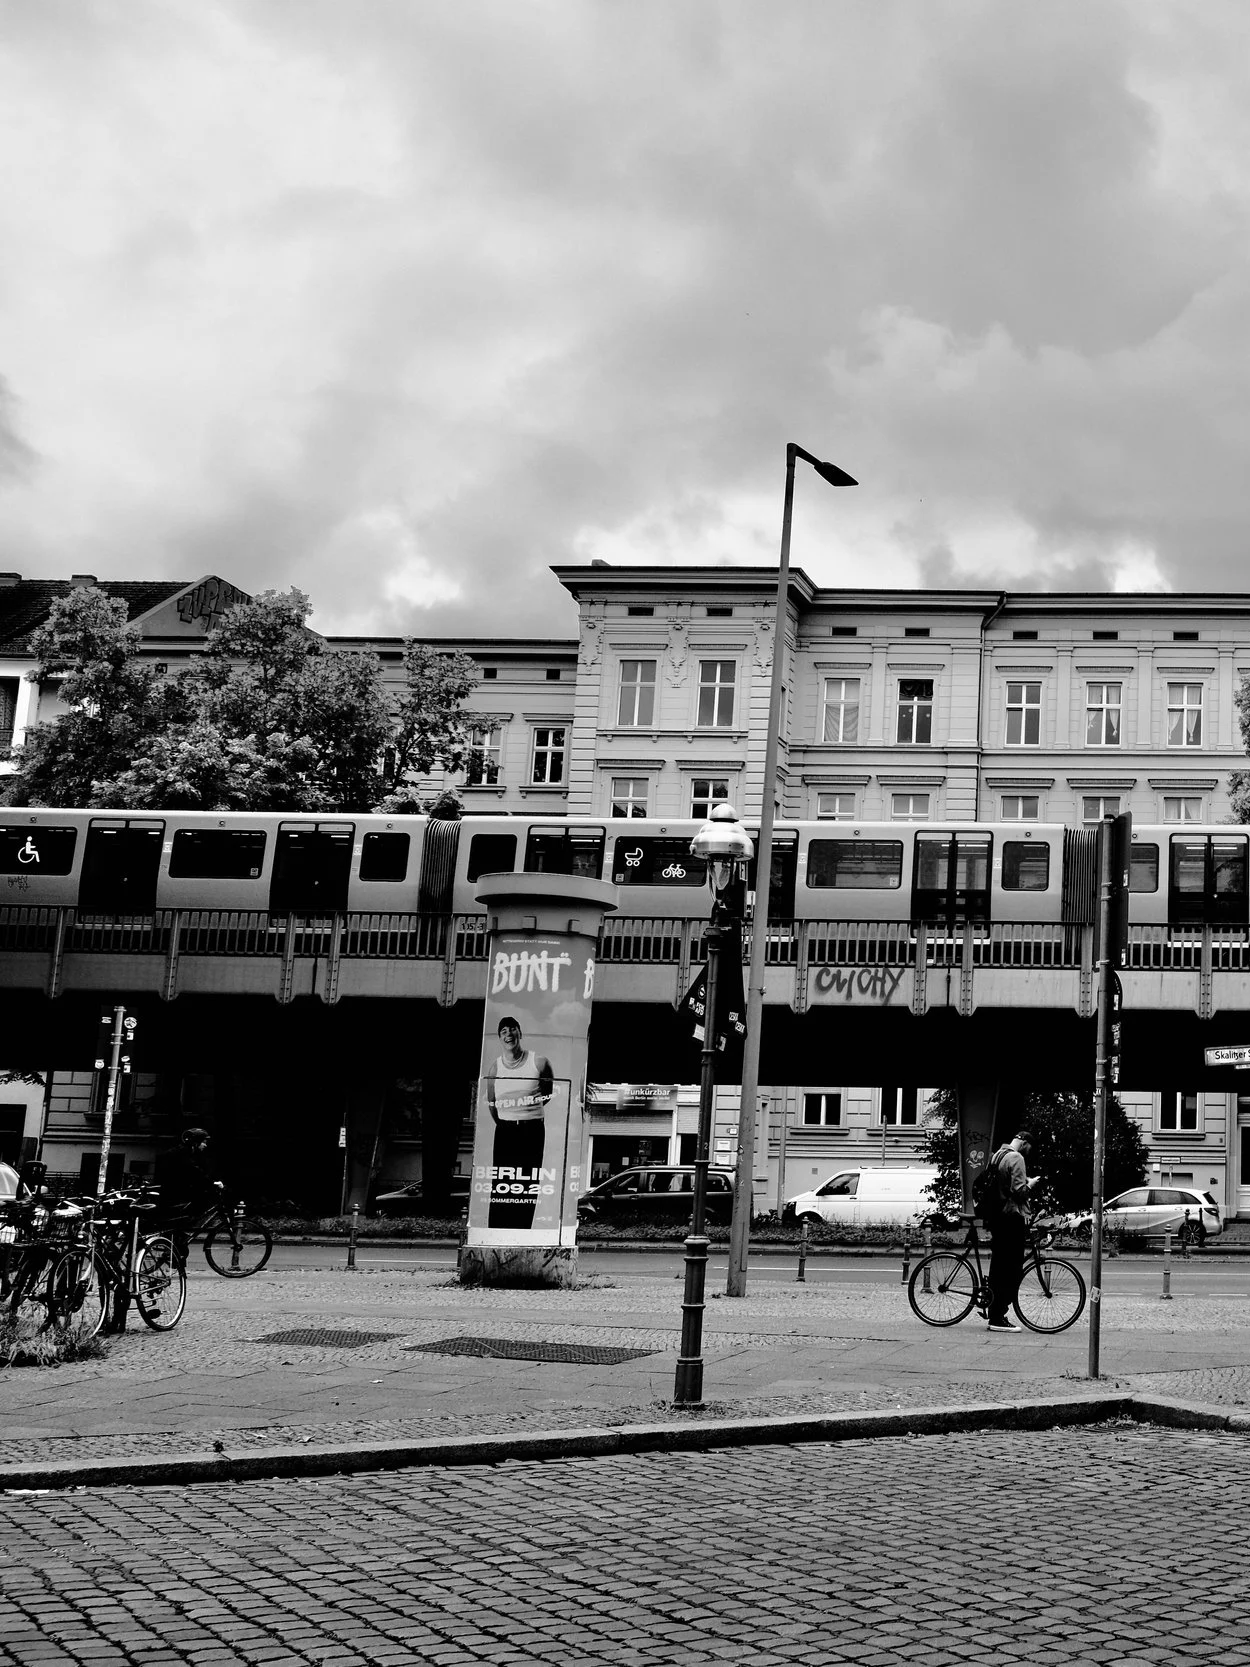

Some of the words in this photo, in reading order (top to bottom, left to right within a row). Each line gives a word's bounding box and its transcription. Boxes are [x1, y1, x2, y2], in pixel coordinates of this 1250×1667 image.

[1214, 1050, 1247, 1061] Skalitzer
[475, 1166, 557, 1181] BERLIN
[474, 1182, 555, 1195] 03.09.26
